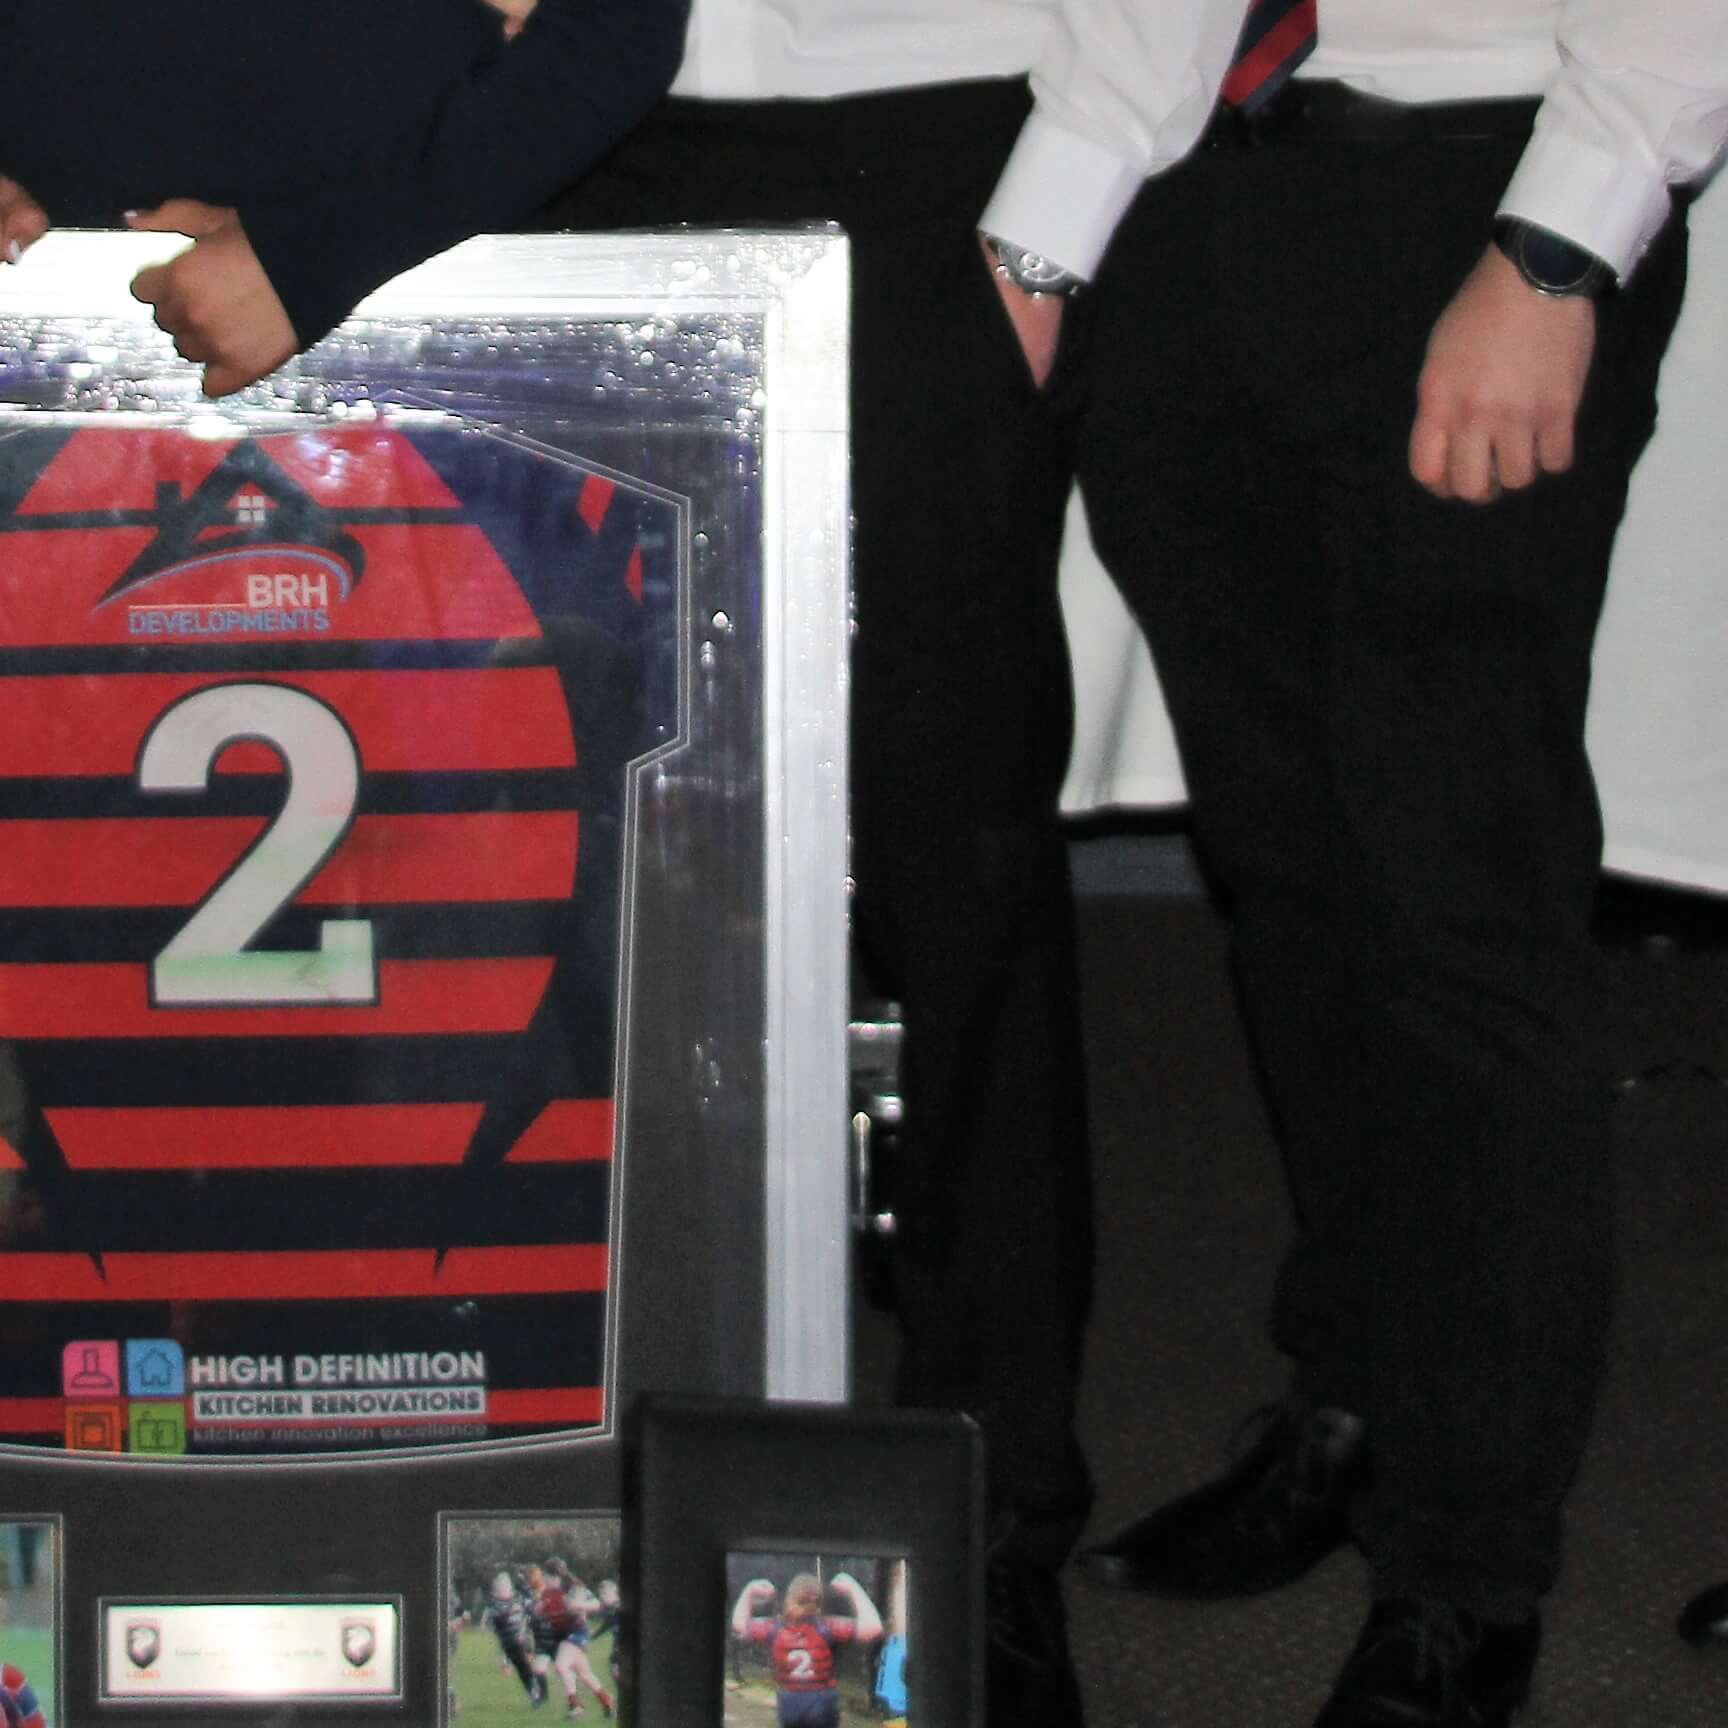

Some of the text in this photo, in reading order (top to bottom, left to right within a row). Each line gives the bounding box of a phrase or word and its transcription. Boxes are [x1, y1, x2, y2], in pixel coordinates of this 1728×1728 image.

[247, 573, 328, 608] BRH
[128, 608, 329, 635] DEVELOPMENTS
[137, 680, 379, 1009] 2
[190, 1350, 485, 1385] HIGH DEFINITION
[199, 1391, 481, 1415] KITCHEN RENOVATIONS
[192, 1425, 266, 1442] kitchen
[787, 1649, 815, 1679] 2
